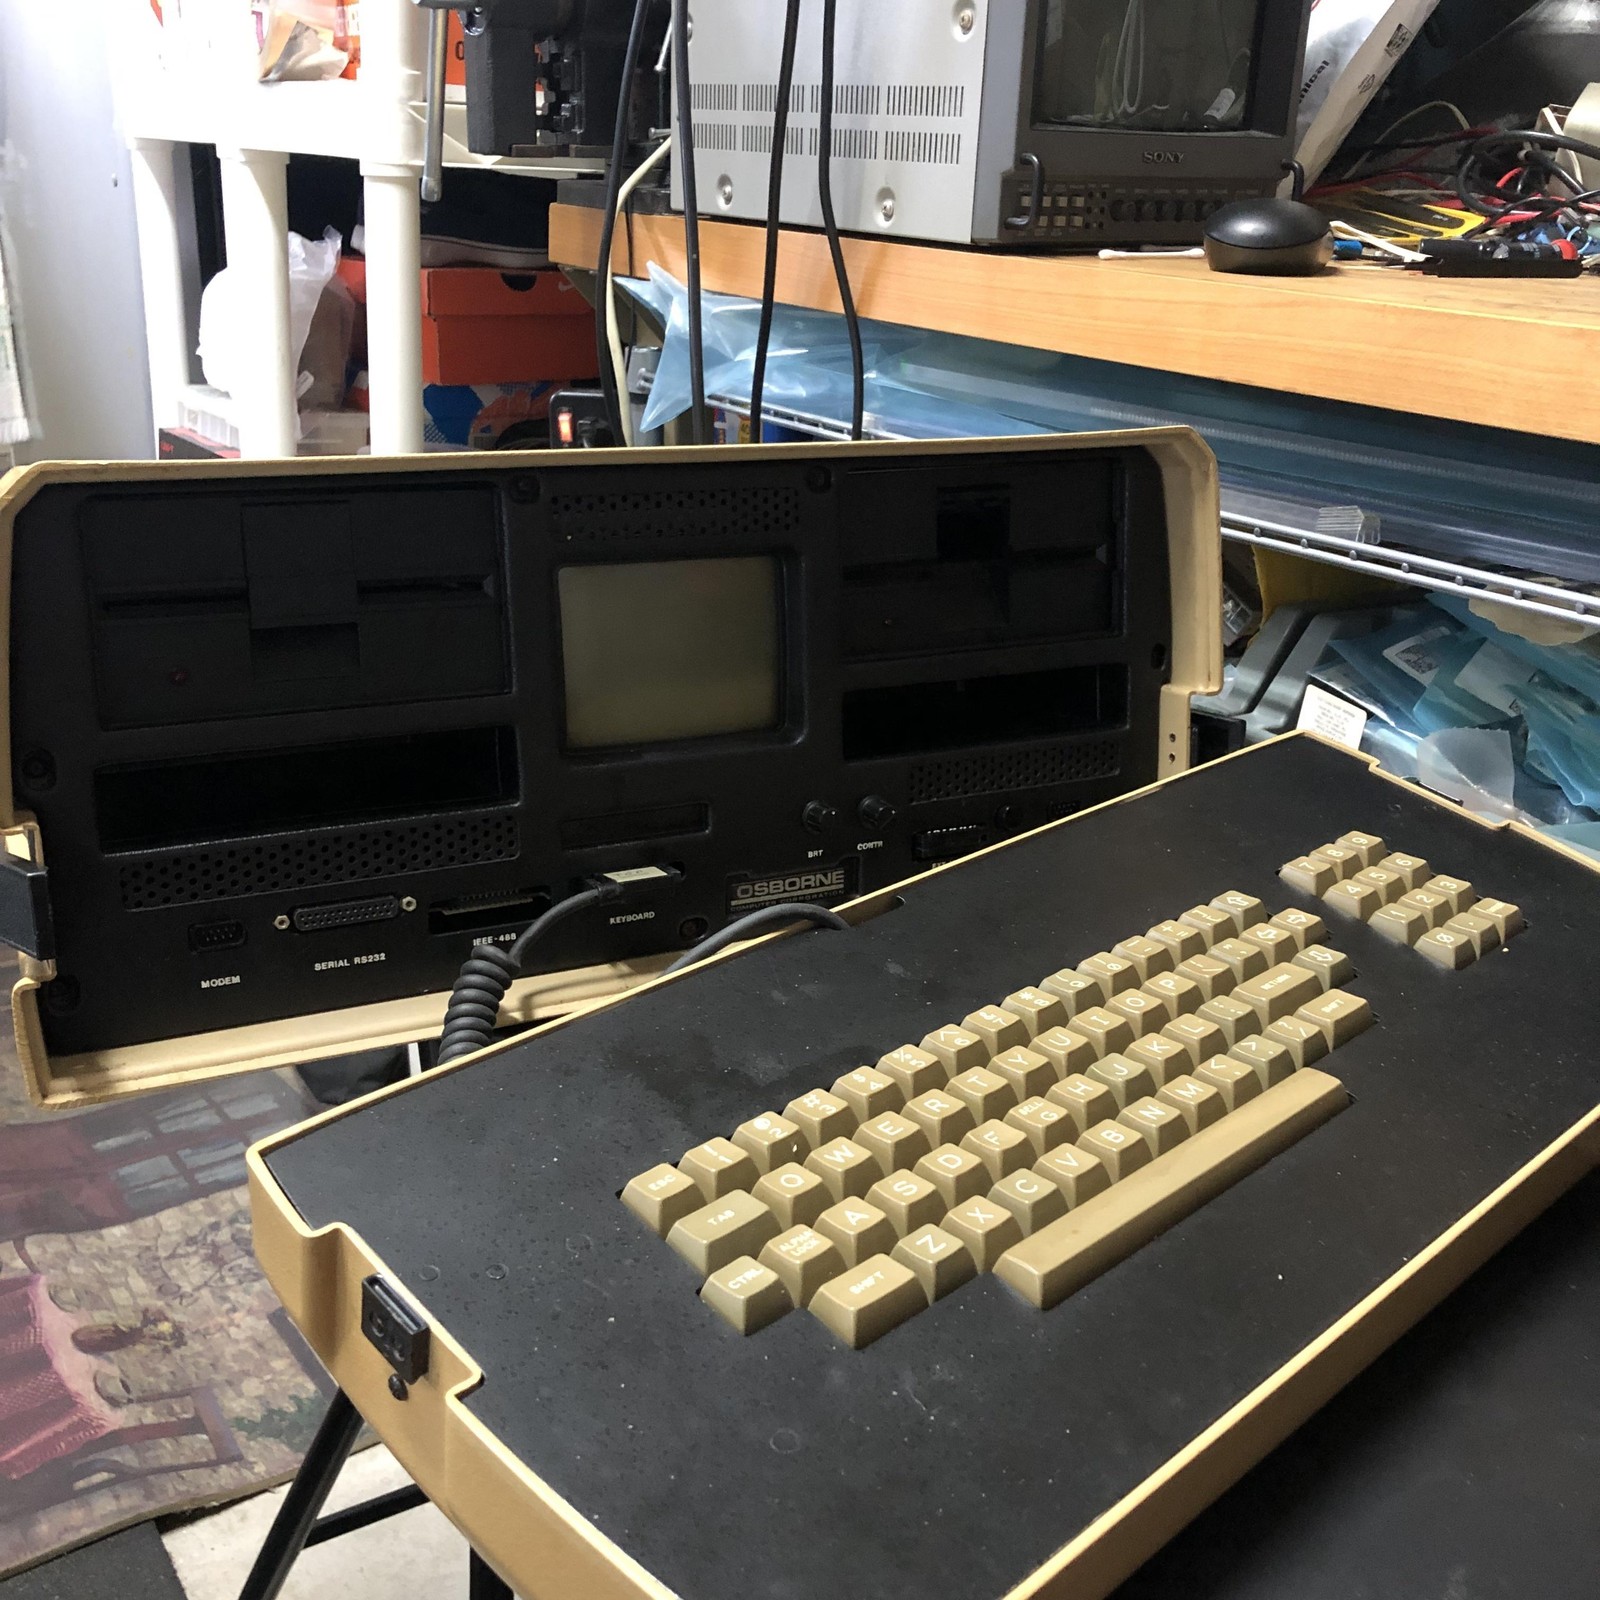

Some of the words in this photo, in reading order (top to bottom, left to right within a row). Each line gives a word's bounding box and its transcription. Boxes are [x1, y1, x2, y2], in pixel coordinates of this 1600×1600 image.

[1142, 151, 1185, 164] SONY
[1352, 837, 1367, 845] 9
[807, 849, 823, 858] BRT
[1298, 861, 1315, 871] 7
[737, 870, 844, 898] OSBORNE
[1347, 885, 1361, 893] 4
[1440, 880, 1458, 889] 3
[1415, 895, 1433, 904] 2
[609, 911, 655, 925] KEYBOARD
[473, 932, 517, 947] IEEE-488
[314, 958, 350, 971] SERIAL
[354, 952, 386, 965] RS232
[201, 975, 241, 989] MODEM
[1159, 978, 1178, 989] P
[1125, 997, 1146, 1008] O
[1090, 1015, 1110, 1026] I
[1181, 1025, 1204, 1033] L
[1047, 1033, 1071, 1048] U
[1146, 1041, 1170, 1053] K
[1008, 1053, 1028, 1067] Y
[1113, 1064, 1128, 1075] J
[967, 1075, 987, 1086] T
[1068, 1081, 1093, 1095] H
[1174, 1083, 1203, 1098] M
[924, 1099, 949, 1114] R
[1139, 1105, 1165, 1119] N
[1040, 1111, 1058, 1121] G
[877, 1120, 904, 1137] E
[983, 1131, 1001, 1145] F
[1101, 1130, 1124, 1143] B
[824, 1145, 854, 1162] W
[1056, 1153, 1078, 1166] V
[937, 1154, 962, 1169] D
[780, 1174, 804, 1187] Q
[1016, 1180, 1038, 1193] C
[893, 1181, 917, 1195] S
[708, 1210, 734, 1224] TAB
[844, 1209, 870, 1226] A
[967, 1207, 994, 1223] X
[916, 1234, 946, 1253] Z
[729, 1269, 764, 1289] CTRL
